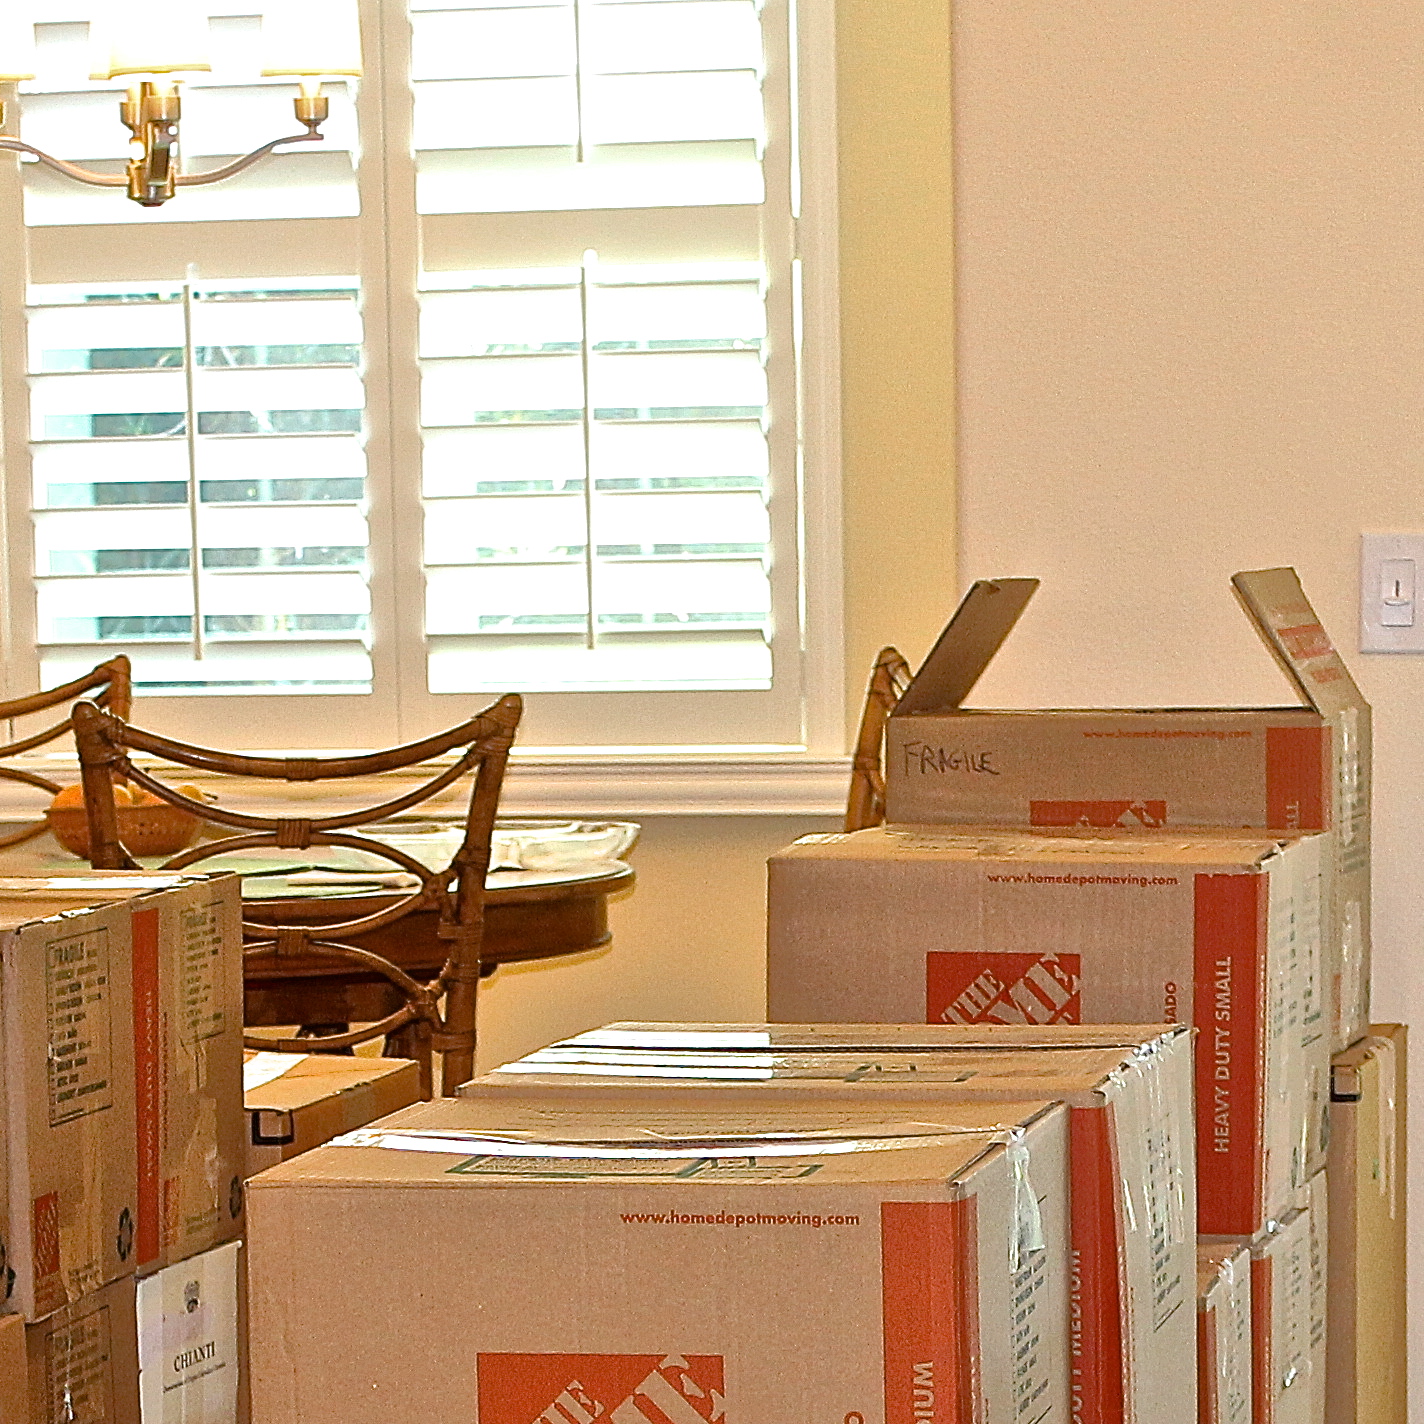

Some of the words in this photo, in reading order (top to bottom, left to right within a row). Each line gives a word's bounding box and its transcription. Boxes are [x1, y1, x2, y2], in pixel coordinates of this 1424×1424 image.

[904, 742, 999, 775] FRAGILE
[987, 872, 1178, 887] www.homedepotmoving.com
[1215, 956, 1232, 1021] SMALL
[1214, 1026, 1231, 1082] DUTY
[1214, 1086, 1231, 1153] HEAVY
[619, 1210, 861, 1230] www.homedepotmoving.com
